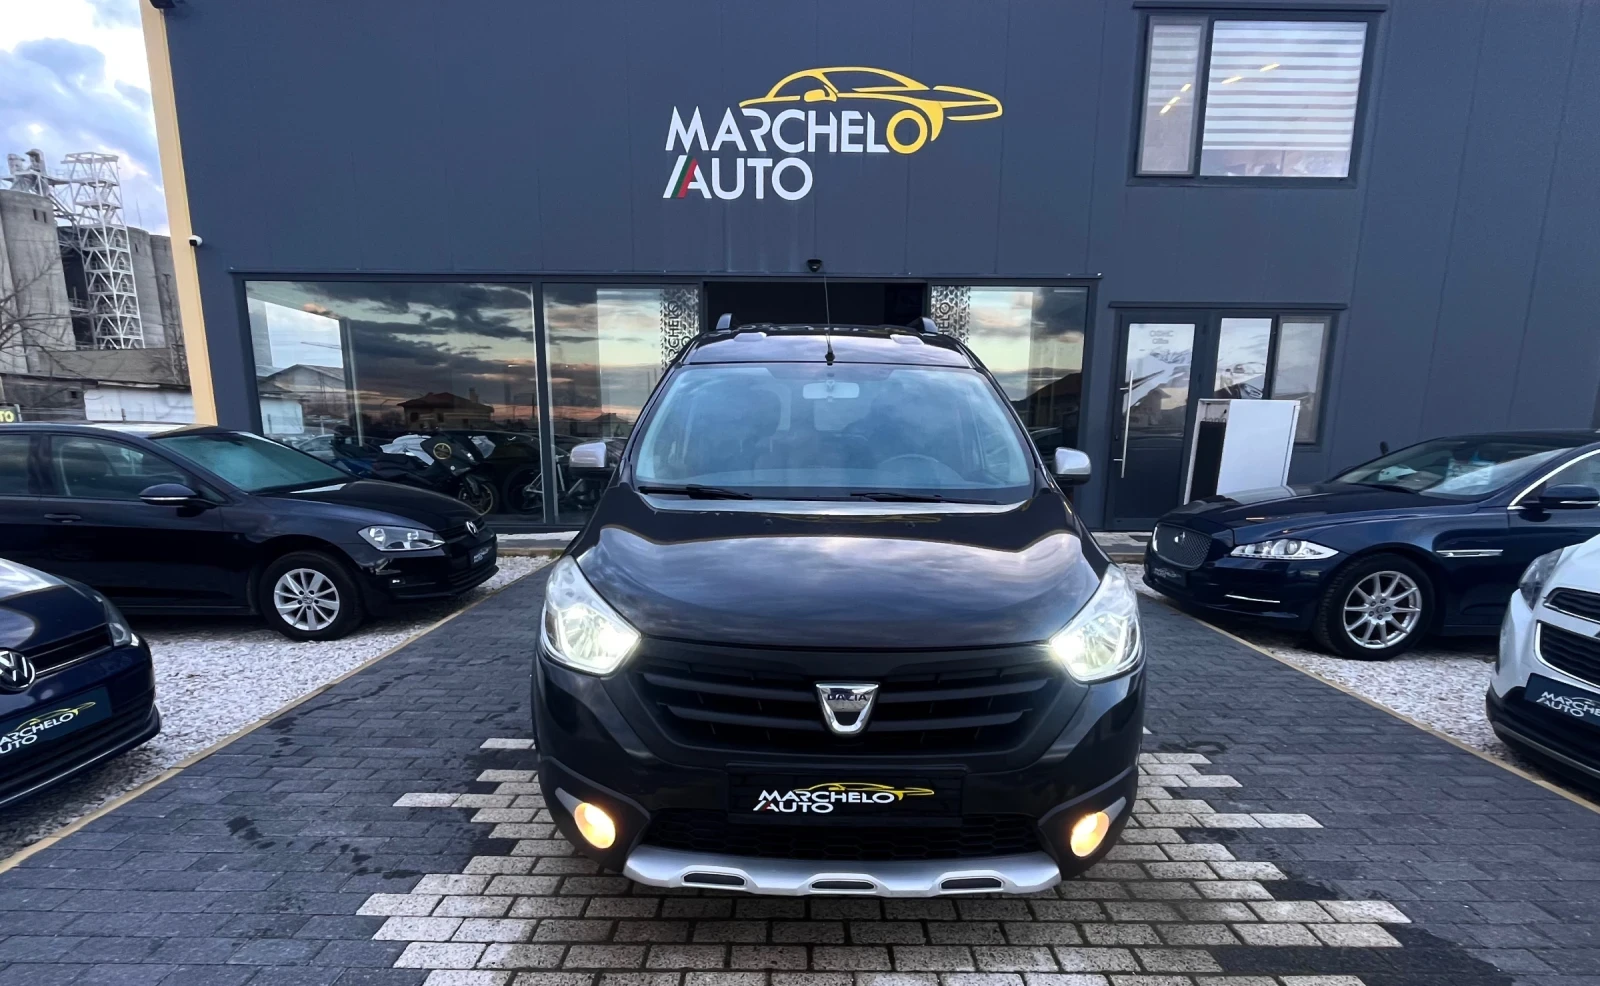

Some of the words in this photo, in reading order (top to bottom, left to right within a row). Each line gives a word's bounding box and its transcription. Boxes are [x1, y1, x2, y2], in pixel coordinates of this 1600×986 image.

[665, 106, 928, 154] MARCHELO
[663, 155, 813, 200] AUTO
[1536, 697, 1584, 717] AUTO
[758, 789, 895, 803] MARCHELO
[753, 800, 834, 813] AUTO
